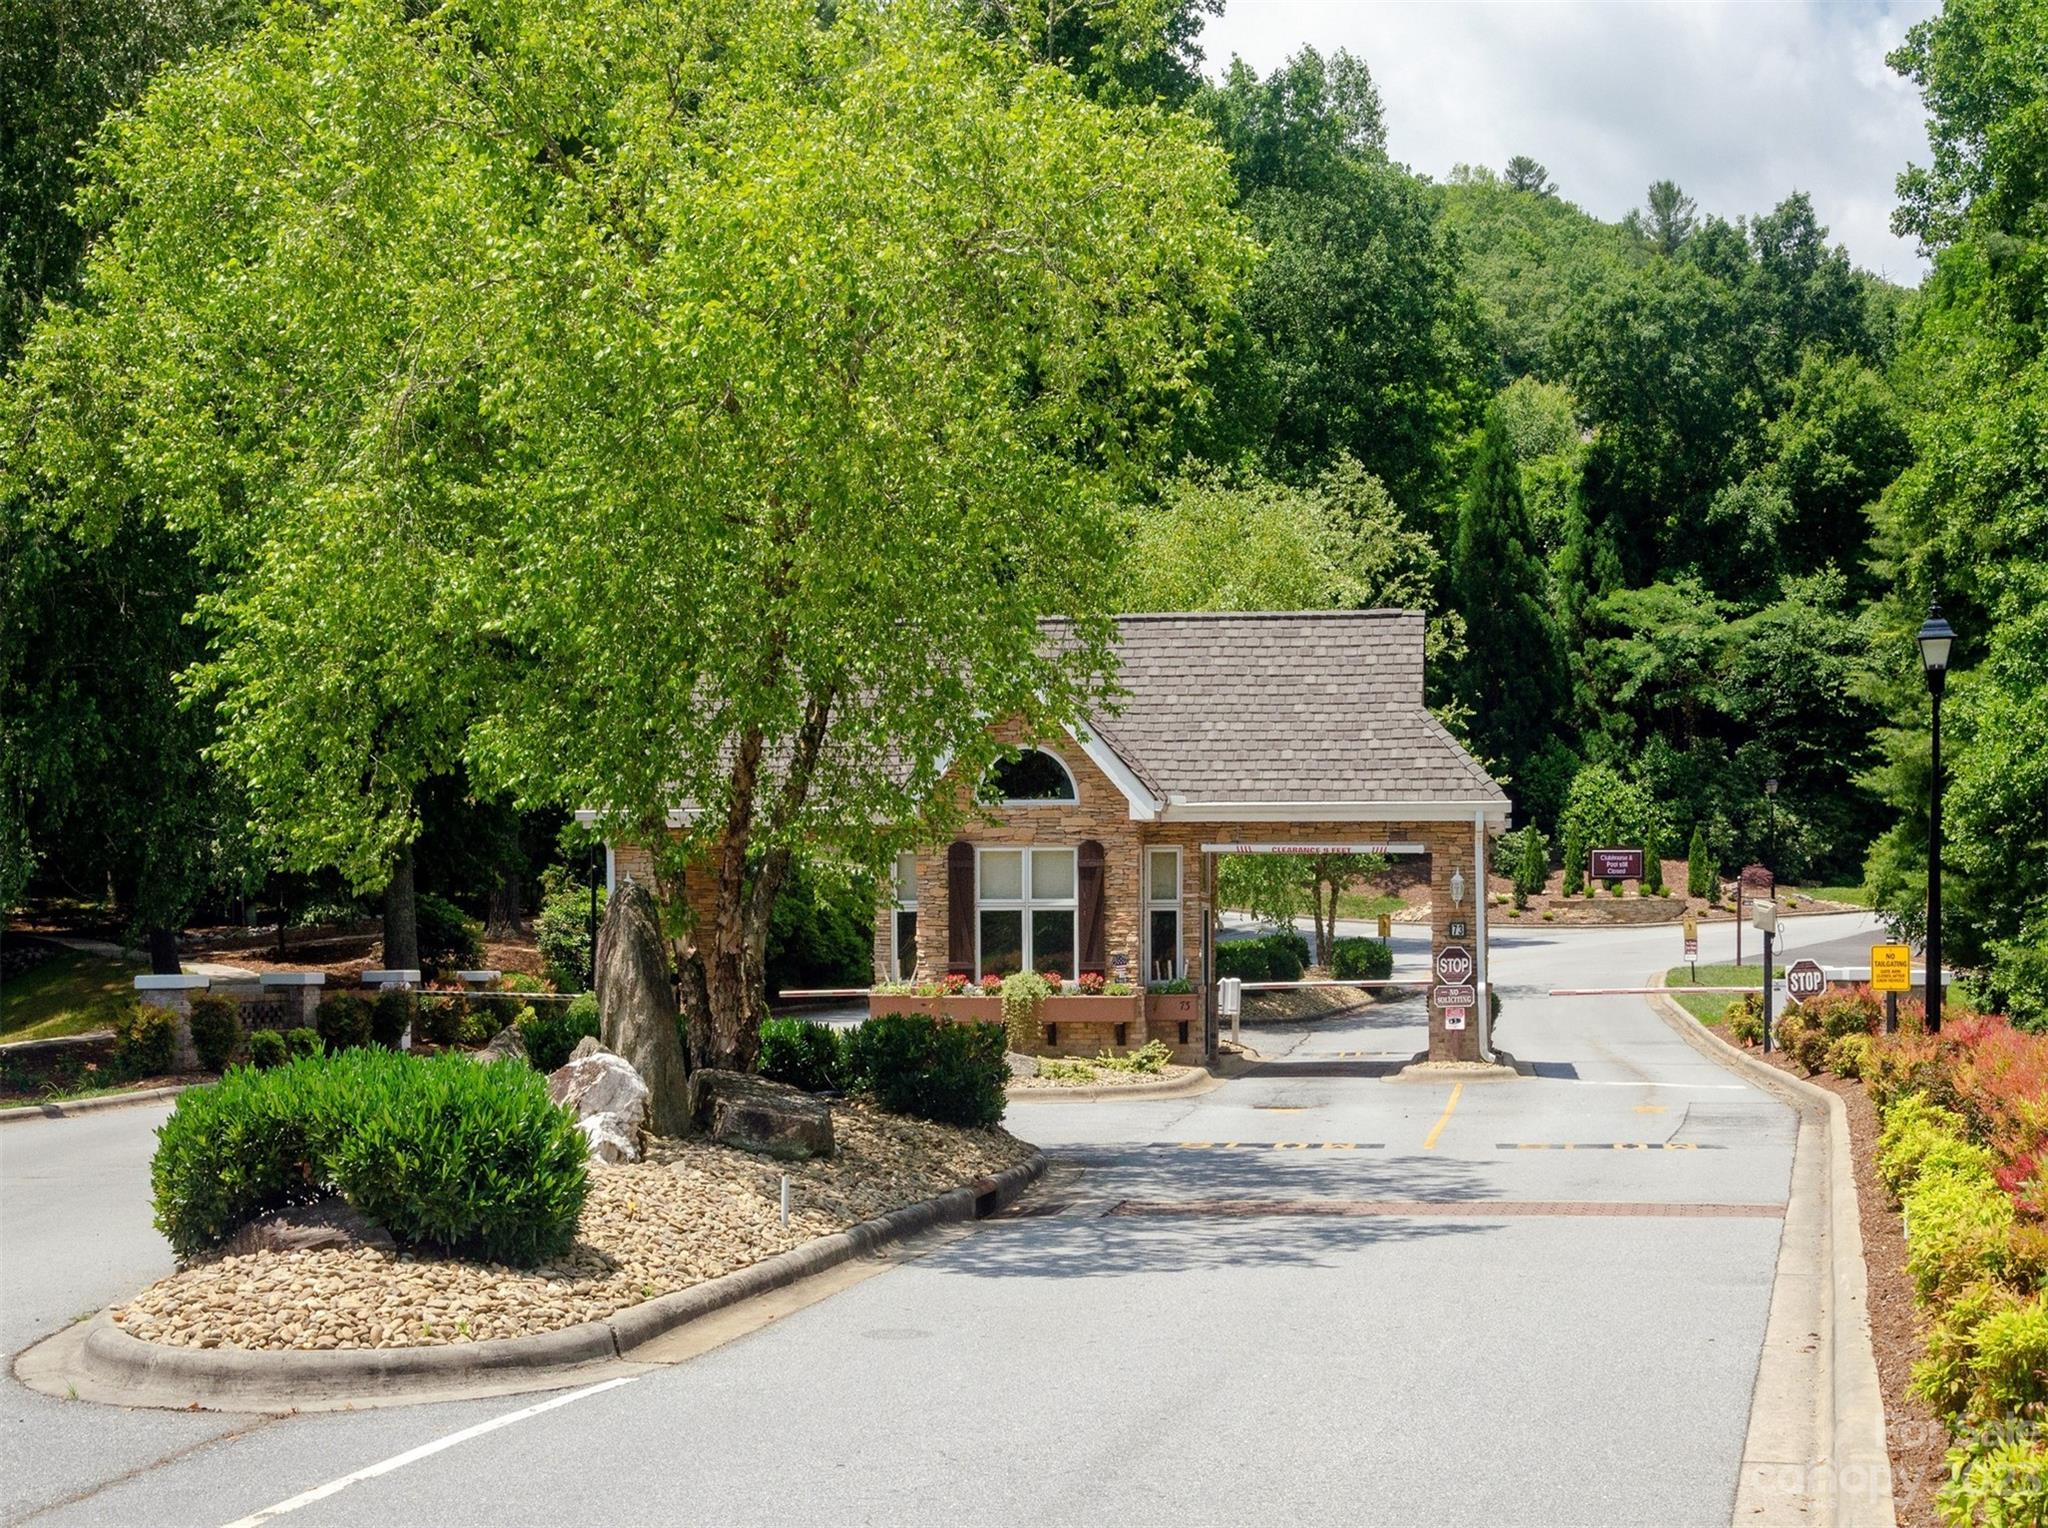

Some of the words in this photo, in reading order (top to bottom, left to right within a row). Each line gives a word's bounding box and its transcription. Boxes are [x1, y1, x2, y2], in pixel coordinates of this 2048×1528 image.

[1271, 846, 1320, 854] CLEARANCE
[1451, 923, 1465, 936] 73
[1440, 958, 1469, 973] STOP
[1790, 972, 1821, 991] STOP
[1449, 988, 1459, 996] NO
[1437, 995, 1472, 1004] SOLICITING
